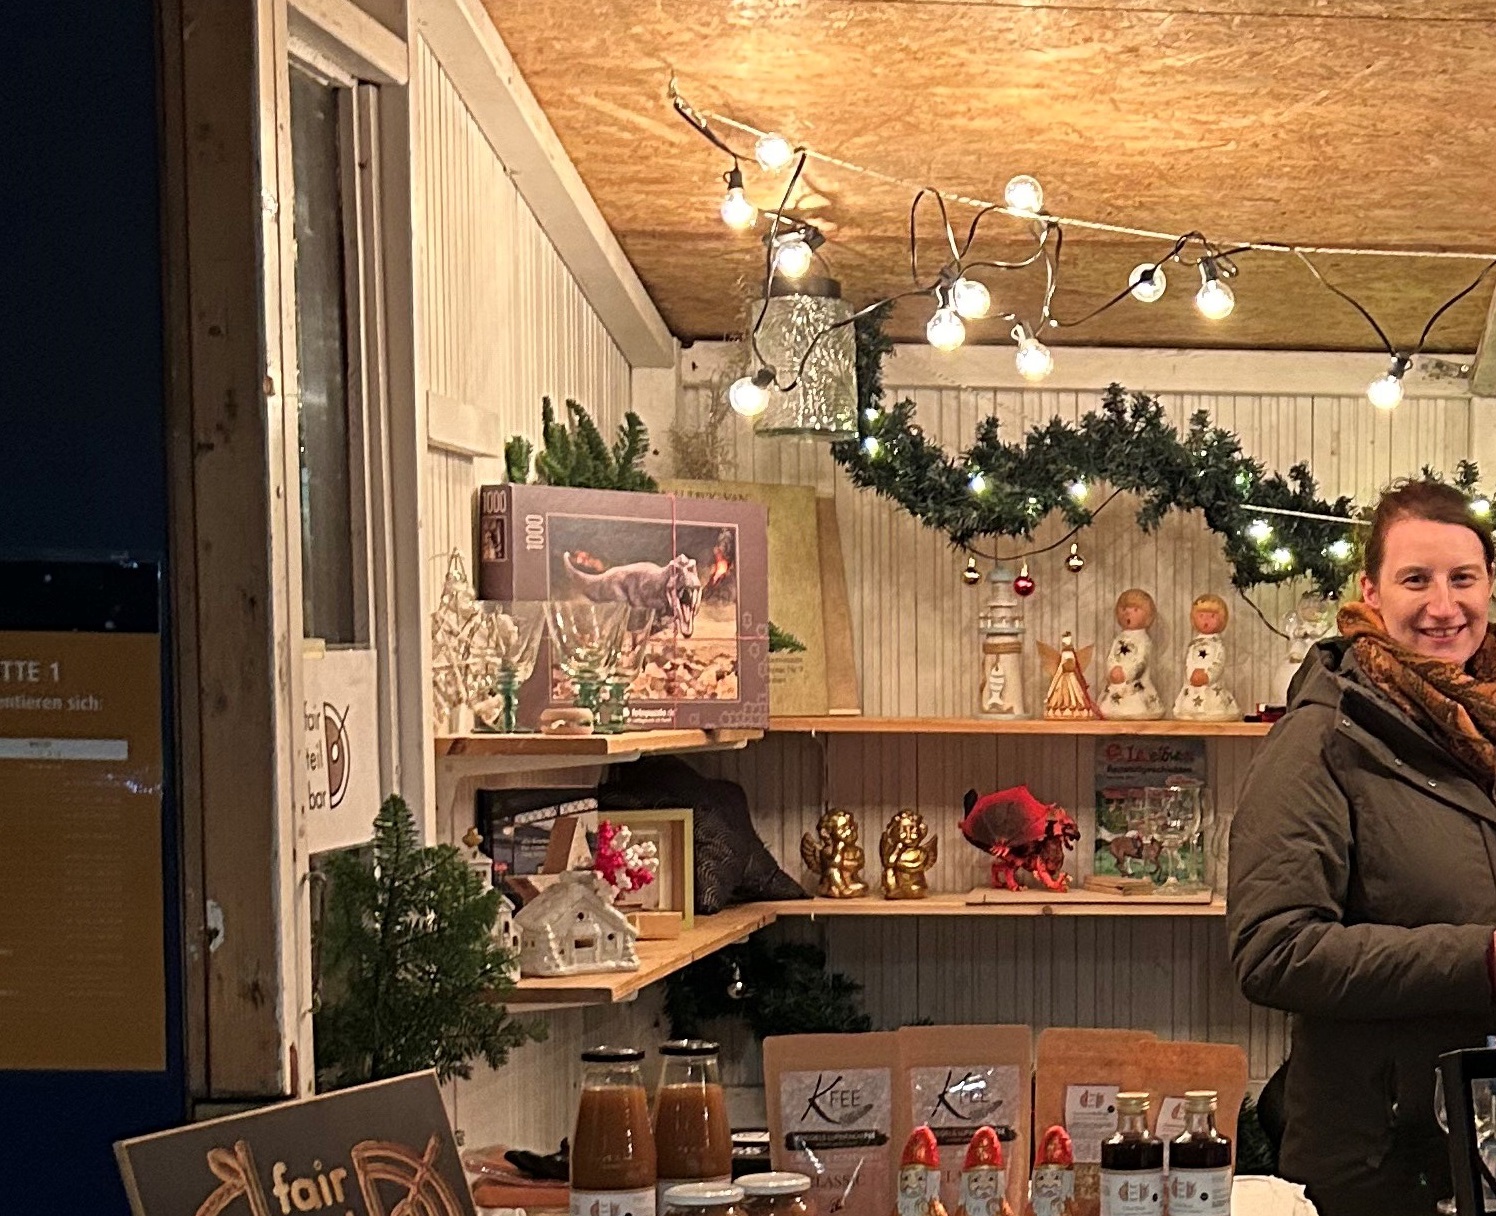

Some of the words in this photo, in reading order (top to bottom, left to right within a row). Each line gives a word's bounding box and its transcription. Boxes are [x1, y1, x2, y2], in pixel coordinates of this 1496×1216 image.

[482, 489, 508, 514] 1000
[525, 514, 545, 551] 1000
[49, 661, 59, 682] 1
[306, 739, 323, 772] teil
[308, 780, 326, 811] bar
[272, 1160, 348, 1216] fair
